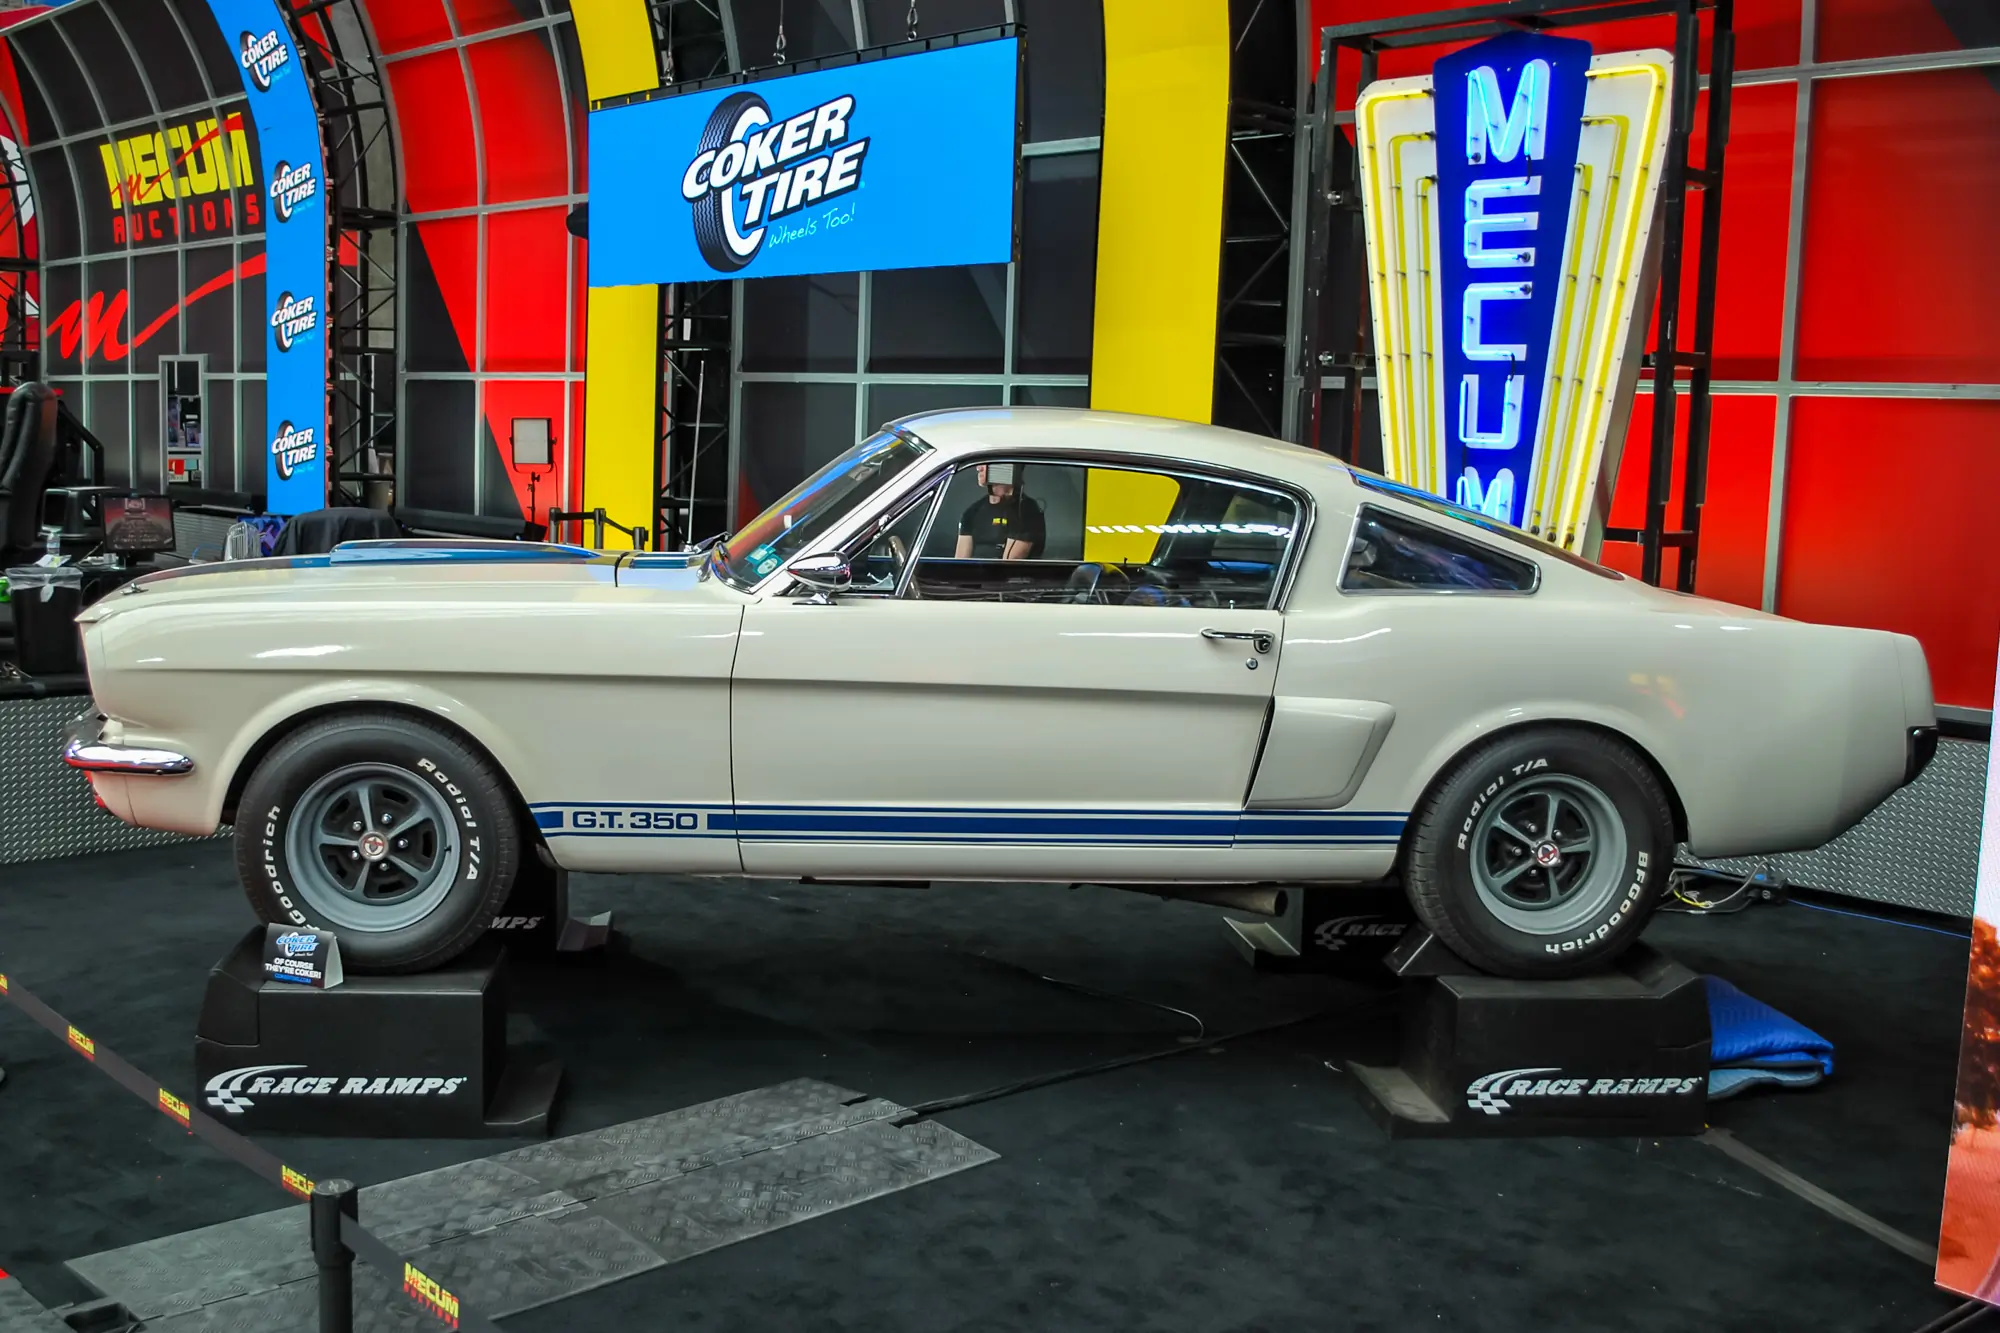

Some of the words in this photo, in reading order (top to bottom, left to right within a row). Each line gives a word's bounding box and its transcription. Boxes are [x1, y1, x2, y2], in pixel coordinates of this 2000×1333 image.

[241, 30, 279, 69] COKER
[260, 44, 288, 75] TIRE
[99, 112, 254, 209] MECUM
[682, 95, 855, 199] COKER
[270, 163, 311, 198] COKER
[286, 178, 316, 206] TIRE
[741, 140, 866, 226] TIRE
[769, 217, 817, 248] Wheels
[822, 203, 856, 230] Too!
[271, 296, 314, 327] COKER
[1456, 59, 1551, 525] MECUM
[286, 311, 317, 337] TIRE
[271, 428, 314, 454] COKER
[287, 443, 317, 466] TIRE
[417, 758, 477, 828] Radial
[466, 836, 481, 881] T/A
[1457, 776, 1504, 850] Radial
[1512, 758, 1549, 776] T/A
[1545, 851, 1649, 954] BFGoodrich
[247, 1077, 339, 1095] RACE
[339, 1077, 463, 1095] RAMPS
[1504, 1079, 1588, 1096] RACE
[1587, 1077, 1697, 1096] RAMPS
[404, 1261, 459, 1318] MECUM
